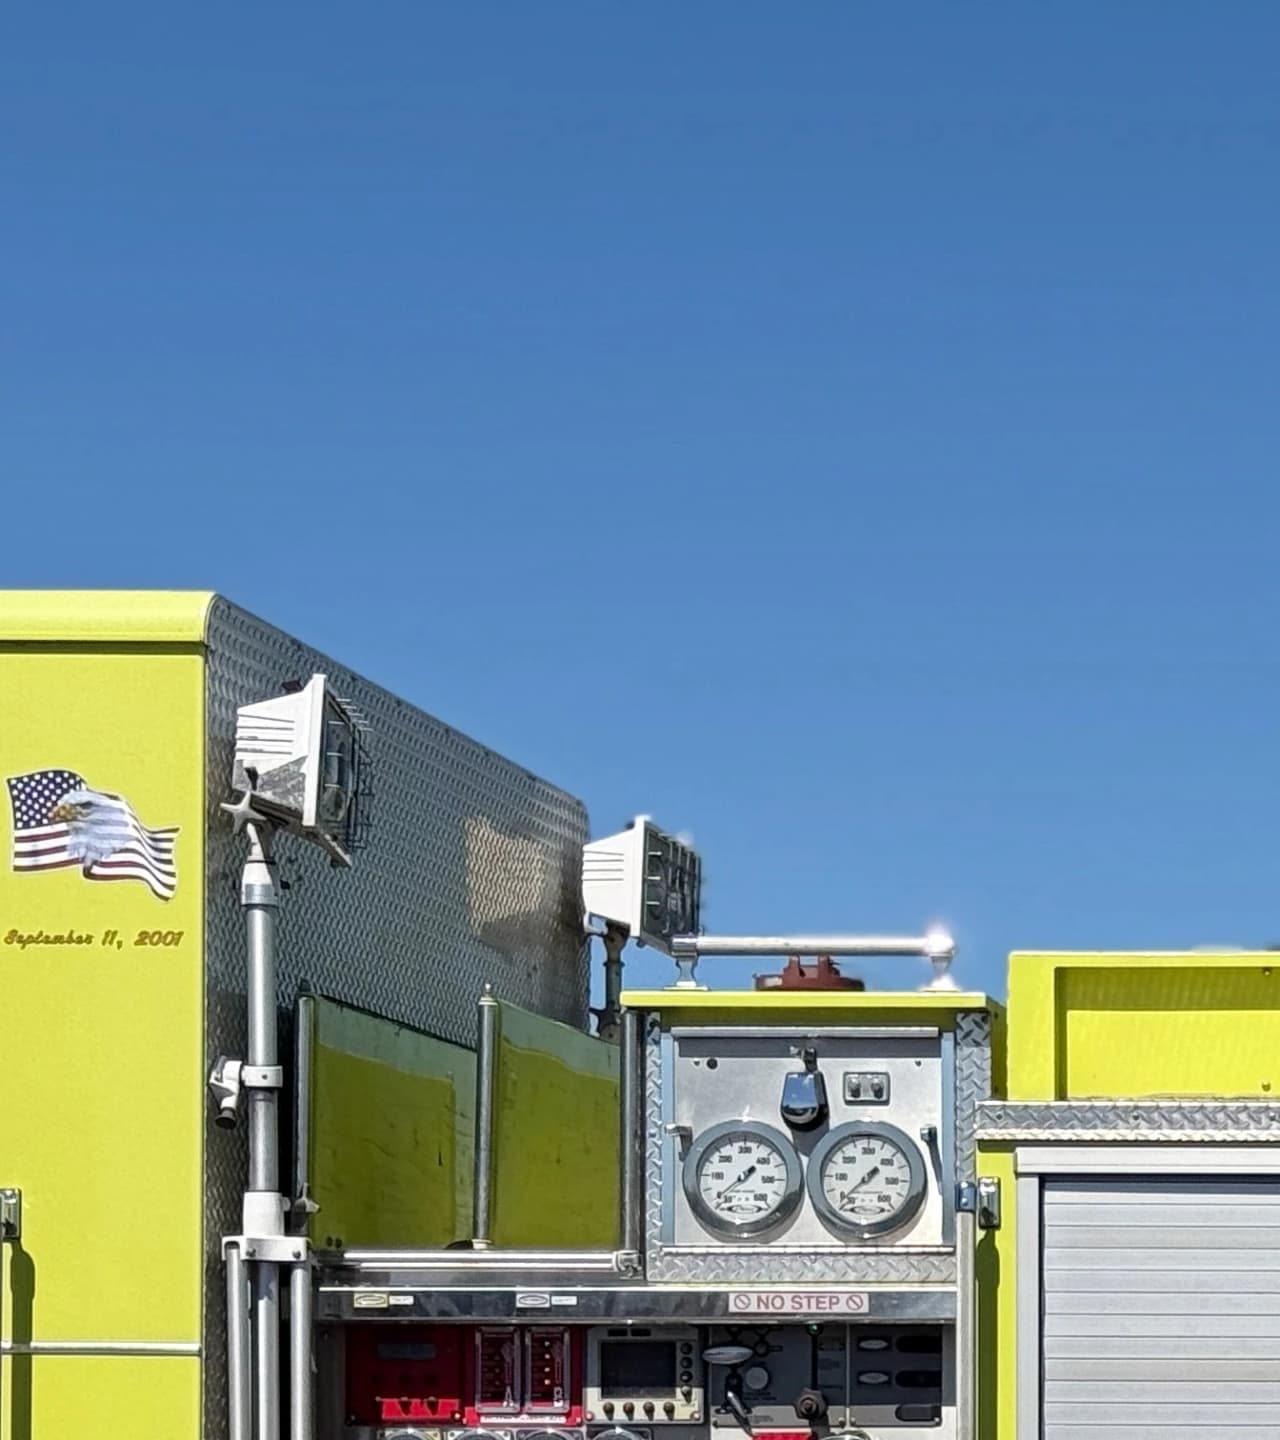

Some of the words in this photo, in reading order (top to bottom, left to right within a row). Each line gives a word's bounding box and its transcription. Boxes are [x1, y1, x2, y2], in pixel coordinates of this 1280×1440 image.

[3, 928, 95, 950] September
[101, 929, 123, 950] 11,
[134, 930, 185, 947] 2001
[756, 1294, 785, 1311] NO
[790, 1294, 841, 1311] STEP
